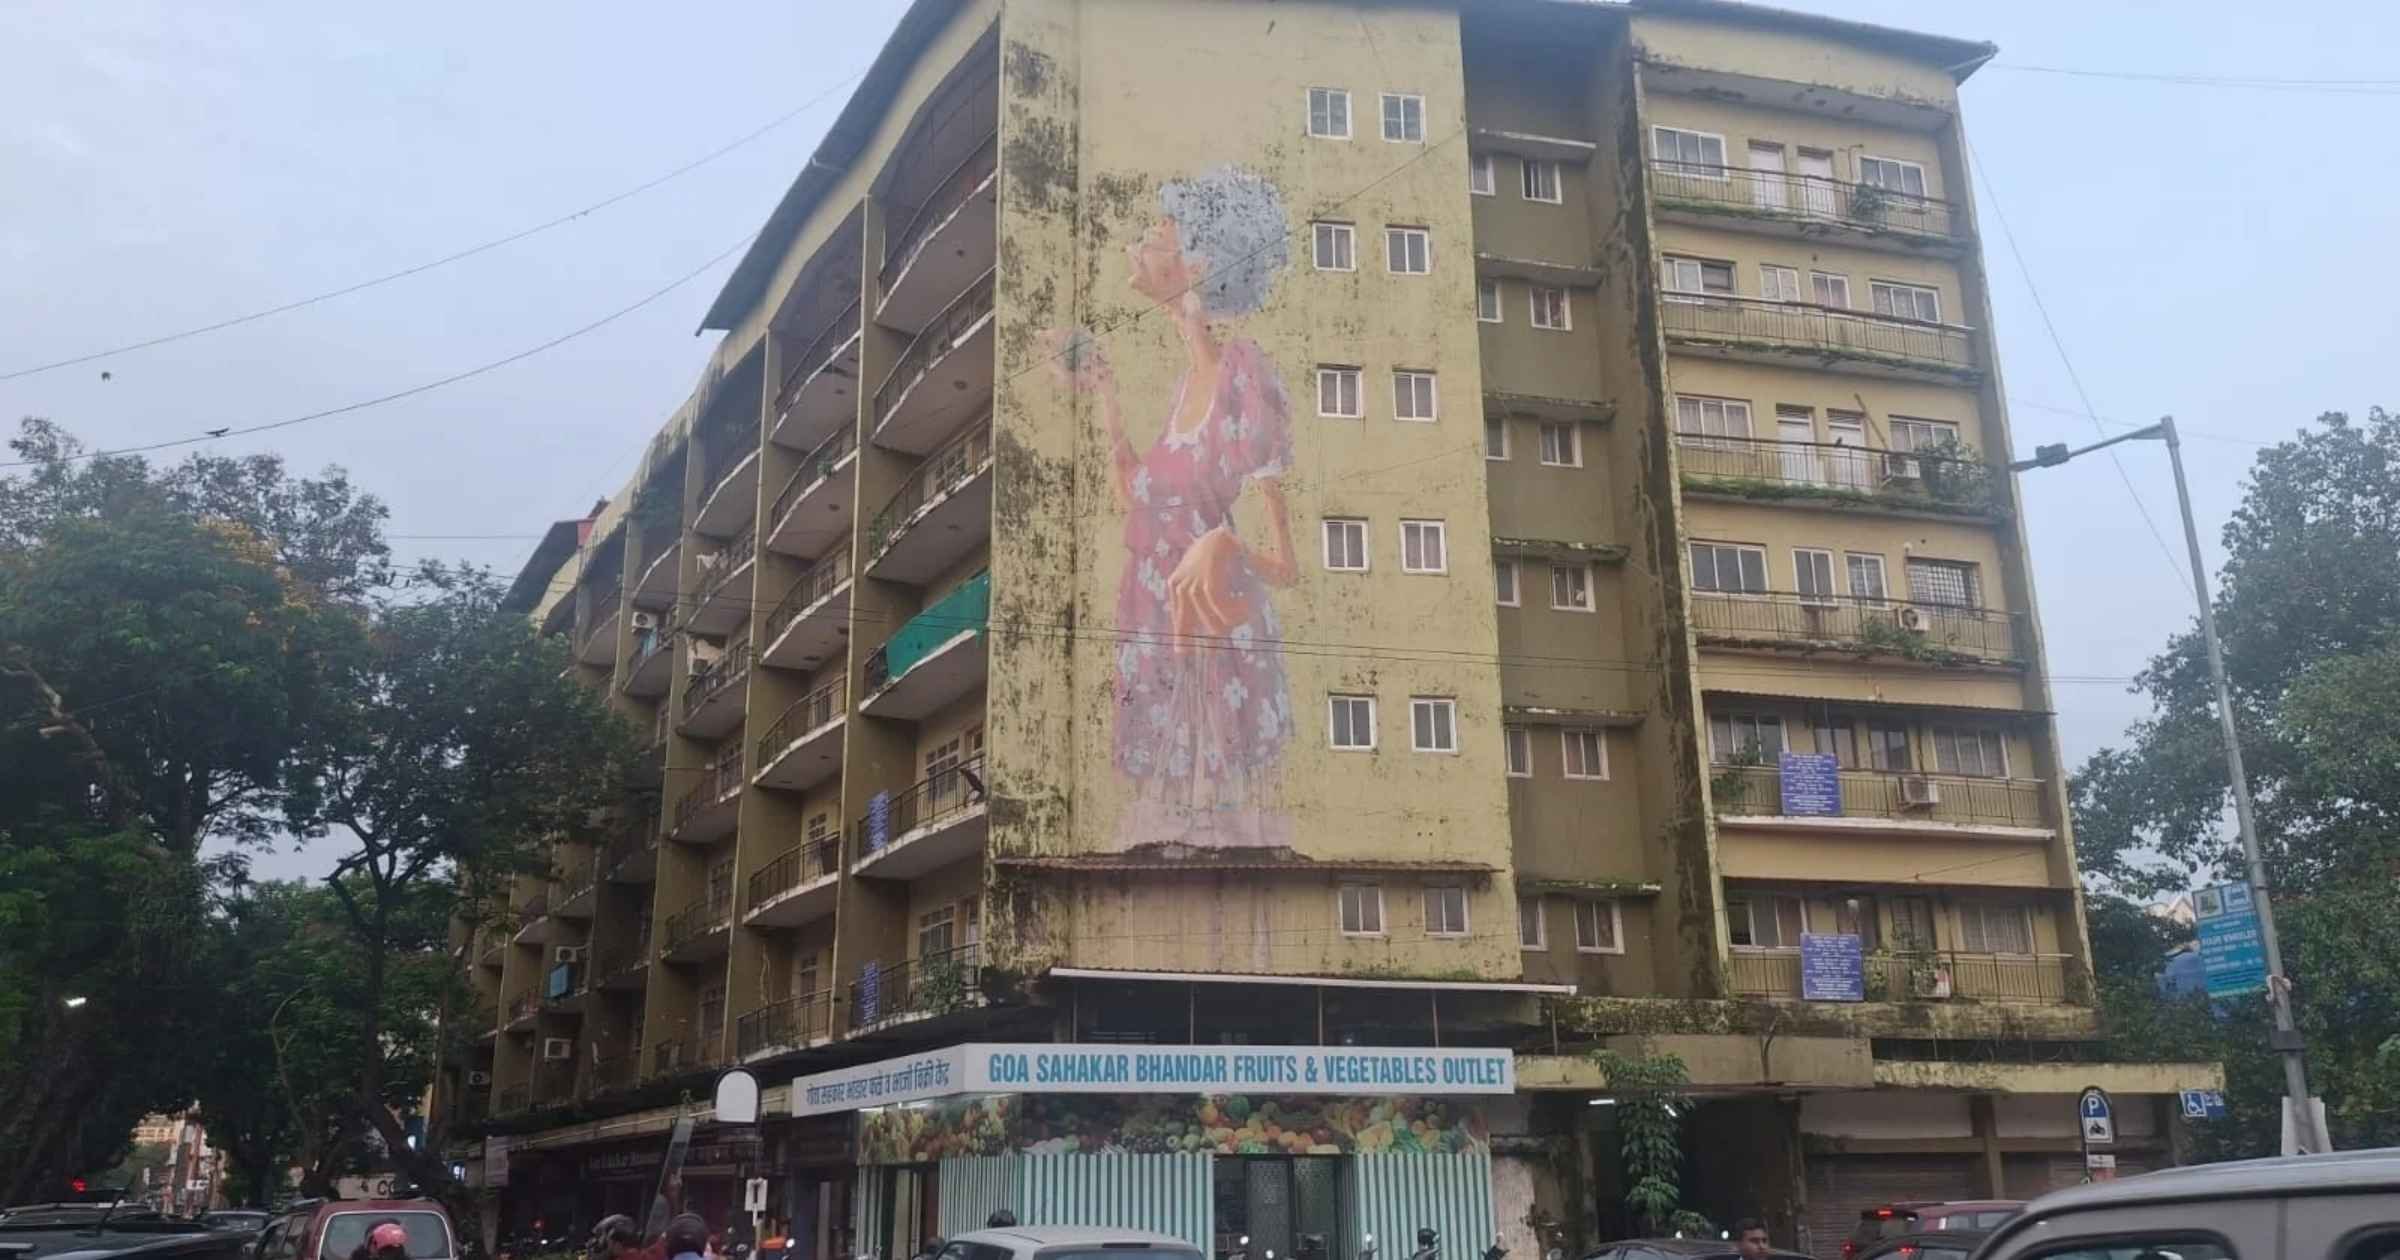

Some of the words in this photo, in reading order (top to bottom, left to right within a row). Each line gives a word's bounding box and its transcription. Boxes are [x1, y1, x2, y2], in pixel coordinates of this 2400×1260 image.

[989, 1054, 1029, 1082] GOA
[1036, 1054, 1129, 1082] SAHAKAR
[1135, 1054, 1227, 1082] BHANDAR
[1234, 1055, 1297, 1083] FRUITS
[1305, 1056, 1318, 1083] &
[1324, 1056, 1436, 1084] VEGETABLES
[1442, 1057, 1505, 1084] OUTLET
[2088, 1097, 2099, 1115] P
